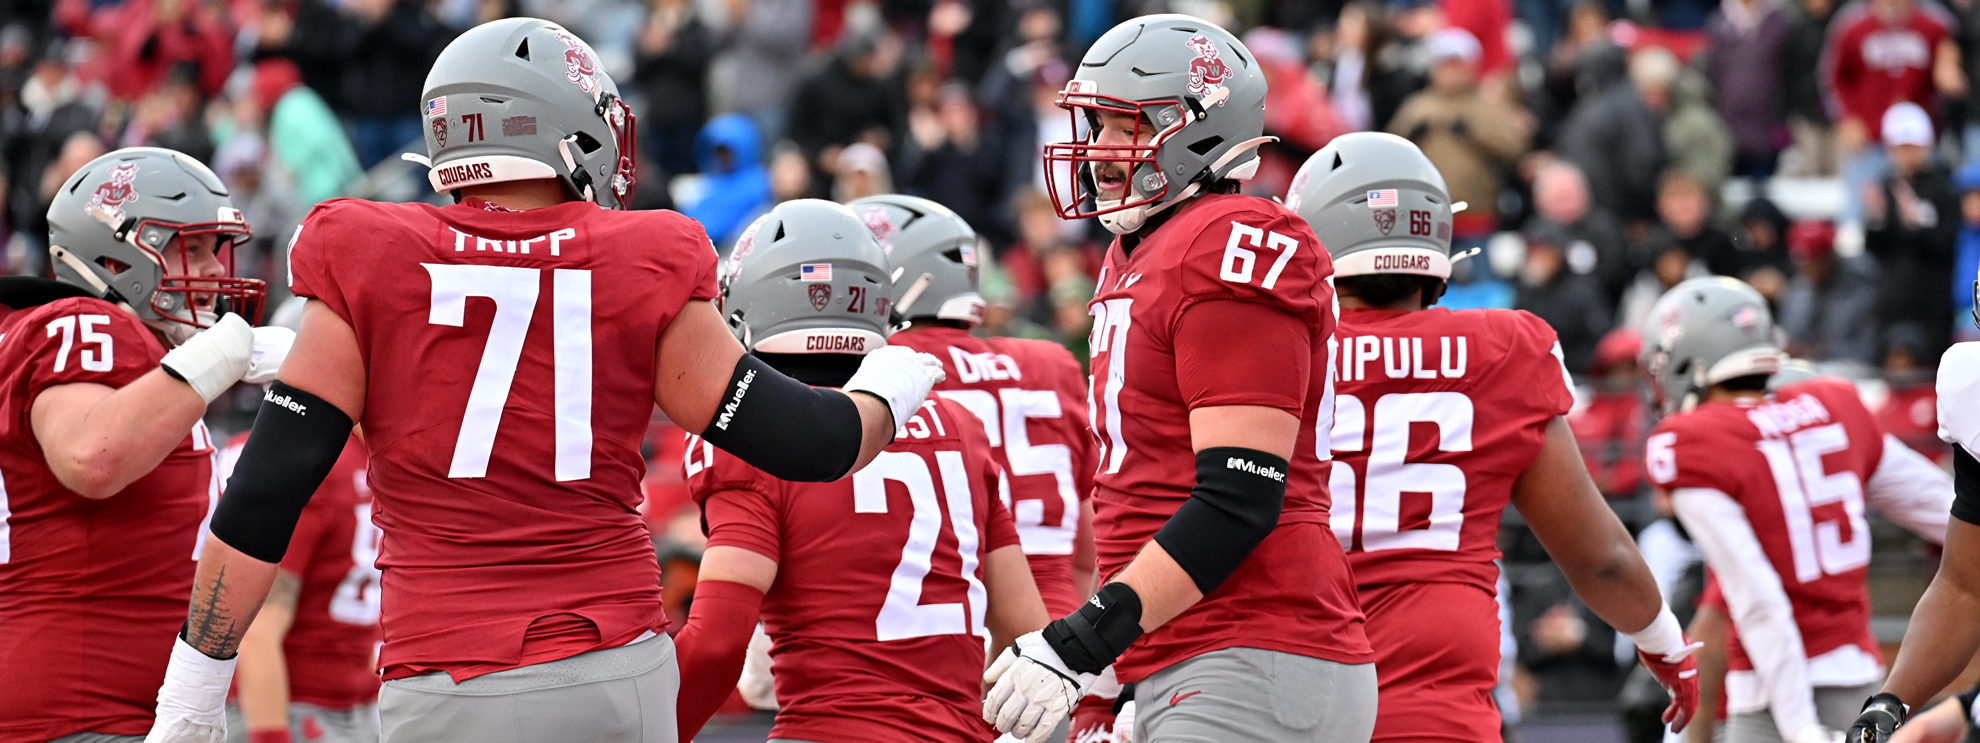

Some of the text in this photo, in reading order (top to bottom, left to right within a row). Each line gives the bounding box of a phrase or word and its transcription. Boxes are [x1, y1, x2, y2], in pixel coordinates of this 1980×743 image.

[1208, 65, 1220, 76] W
[462, 113, 484, 142] 71
[438, 163, 494, 185] COUGARS
[113, 188, 125, 199] W
[1410, 210, 1432, 236] 66
[449, 226, 576, 256] TRIPP
[1220, 220, 1299, 290] 67
[1374, 254, 1431, 271] COUGARS
[847, 286, 867, 314] 21
[46, 314, 114, 373] 75
[806, 335, 866, 352] COUGARS
[420, 262, 593, 482] 71
[1334, 335, 1467, 382] IPULU
[896, 399, 947, 440] ST
[1755, 421, 1873, 584] 15
[852, 450, 989, 642] 21
